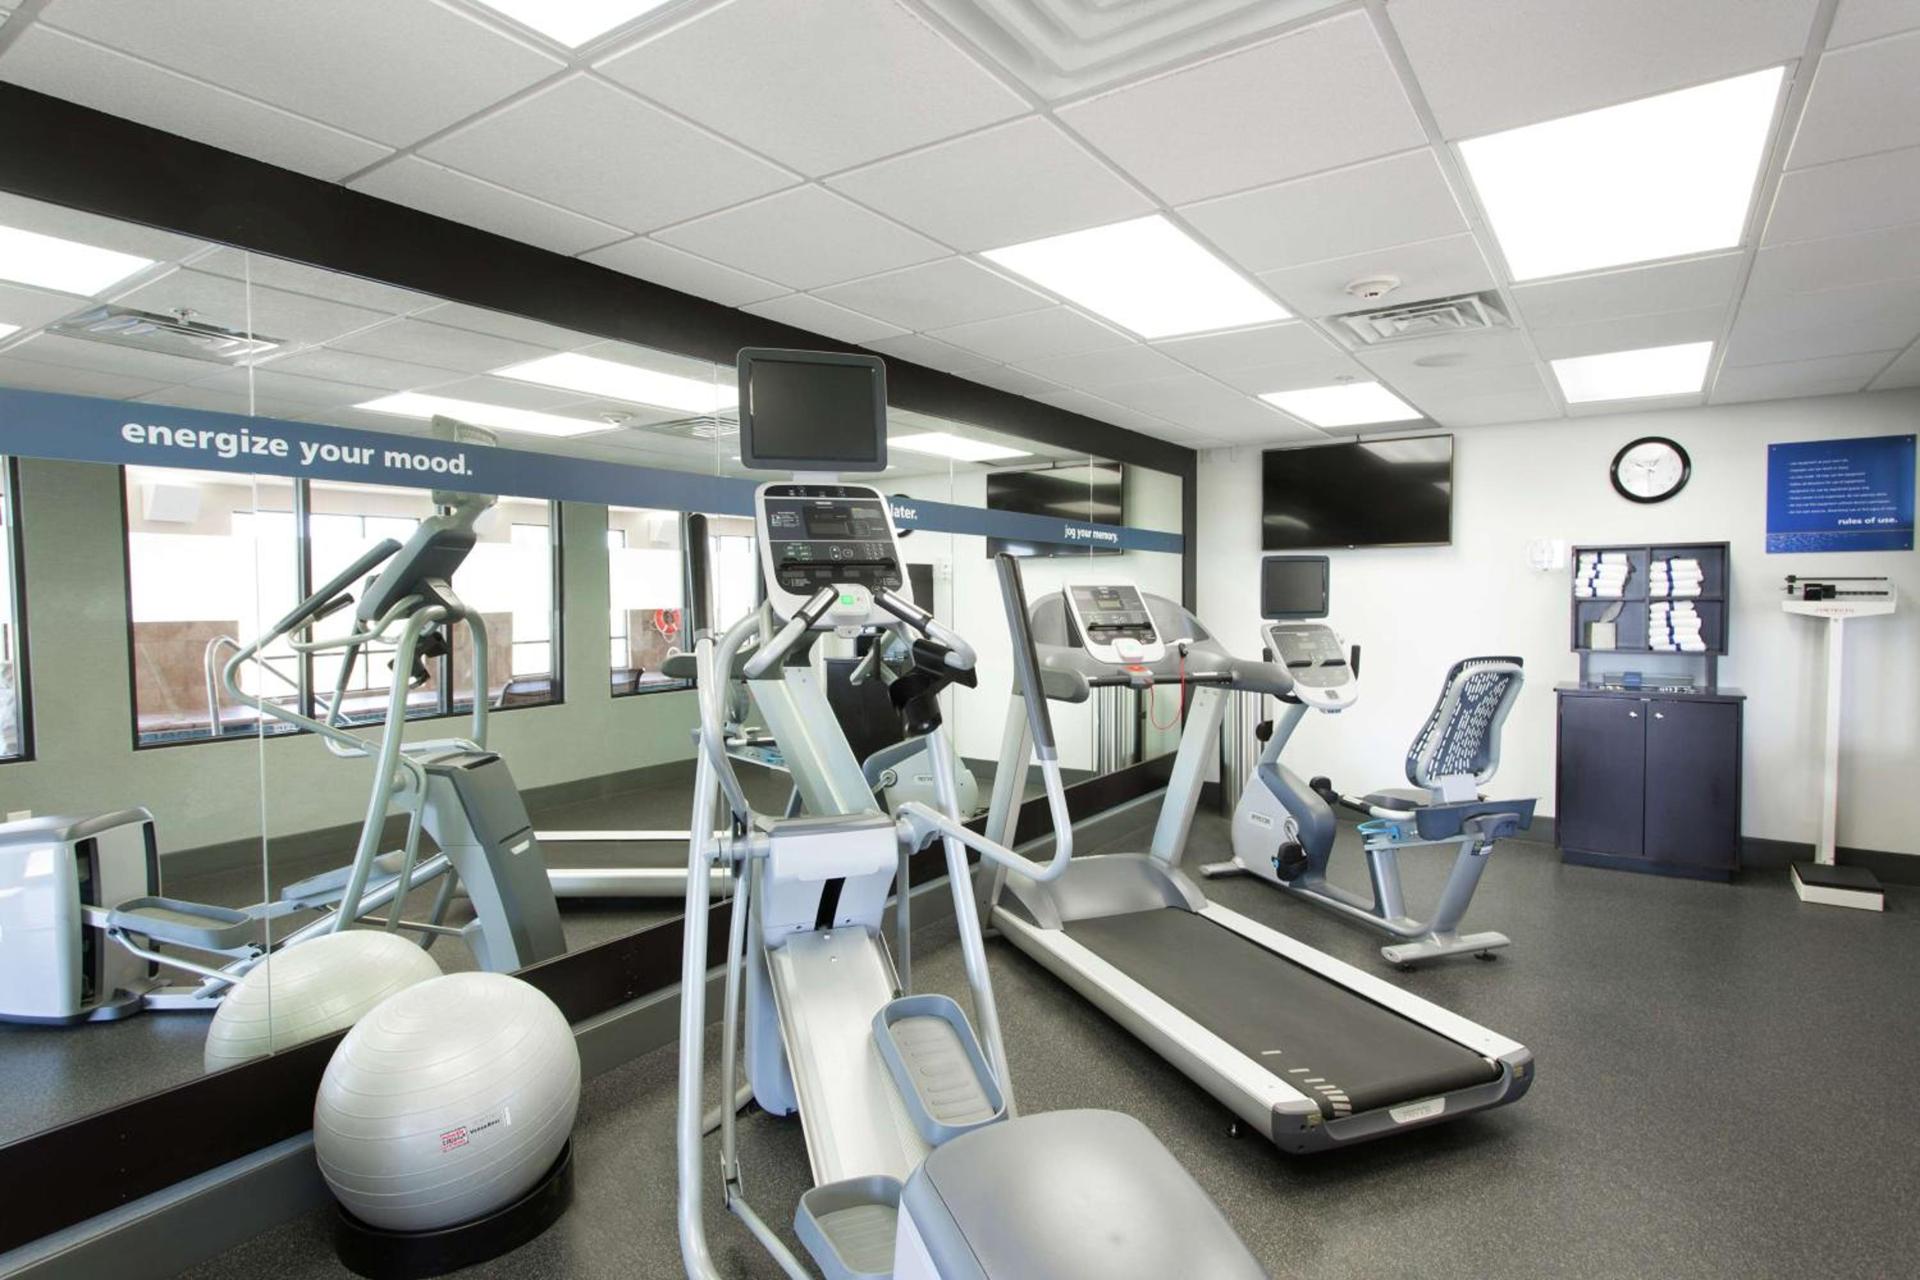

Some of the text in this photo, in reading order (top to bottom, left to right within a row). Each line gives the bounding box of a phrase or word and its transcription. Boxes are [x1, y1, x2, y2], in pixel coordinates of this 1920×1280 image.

[121, 421, 474, 476] energize your mood.
[889, 503, 918, 520] later.
[1837, 516, 1898, 526] rules of use.
[1064, 523, 1076, 540] jog
[1076, 528, 1092, 540] your
